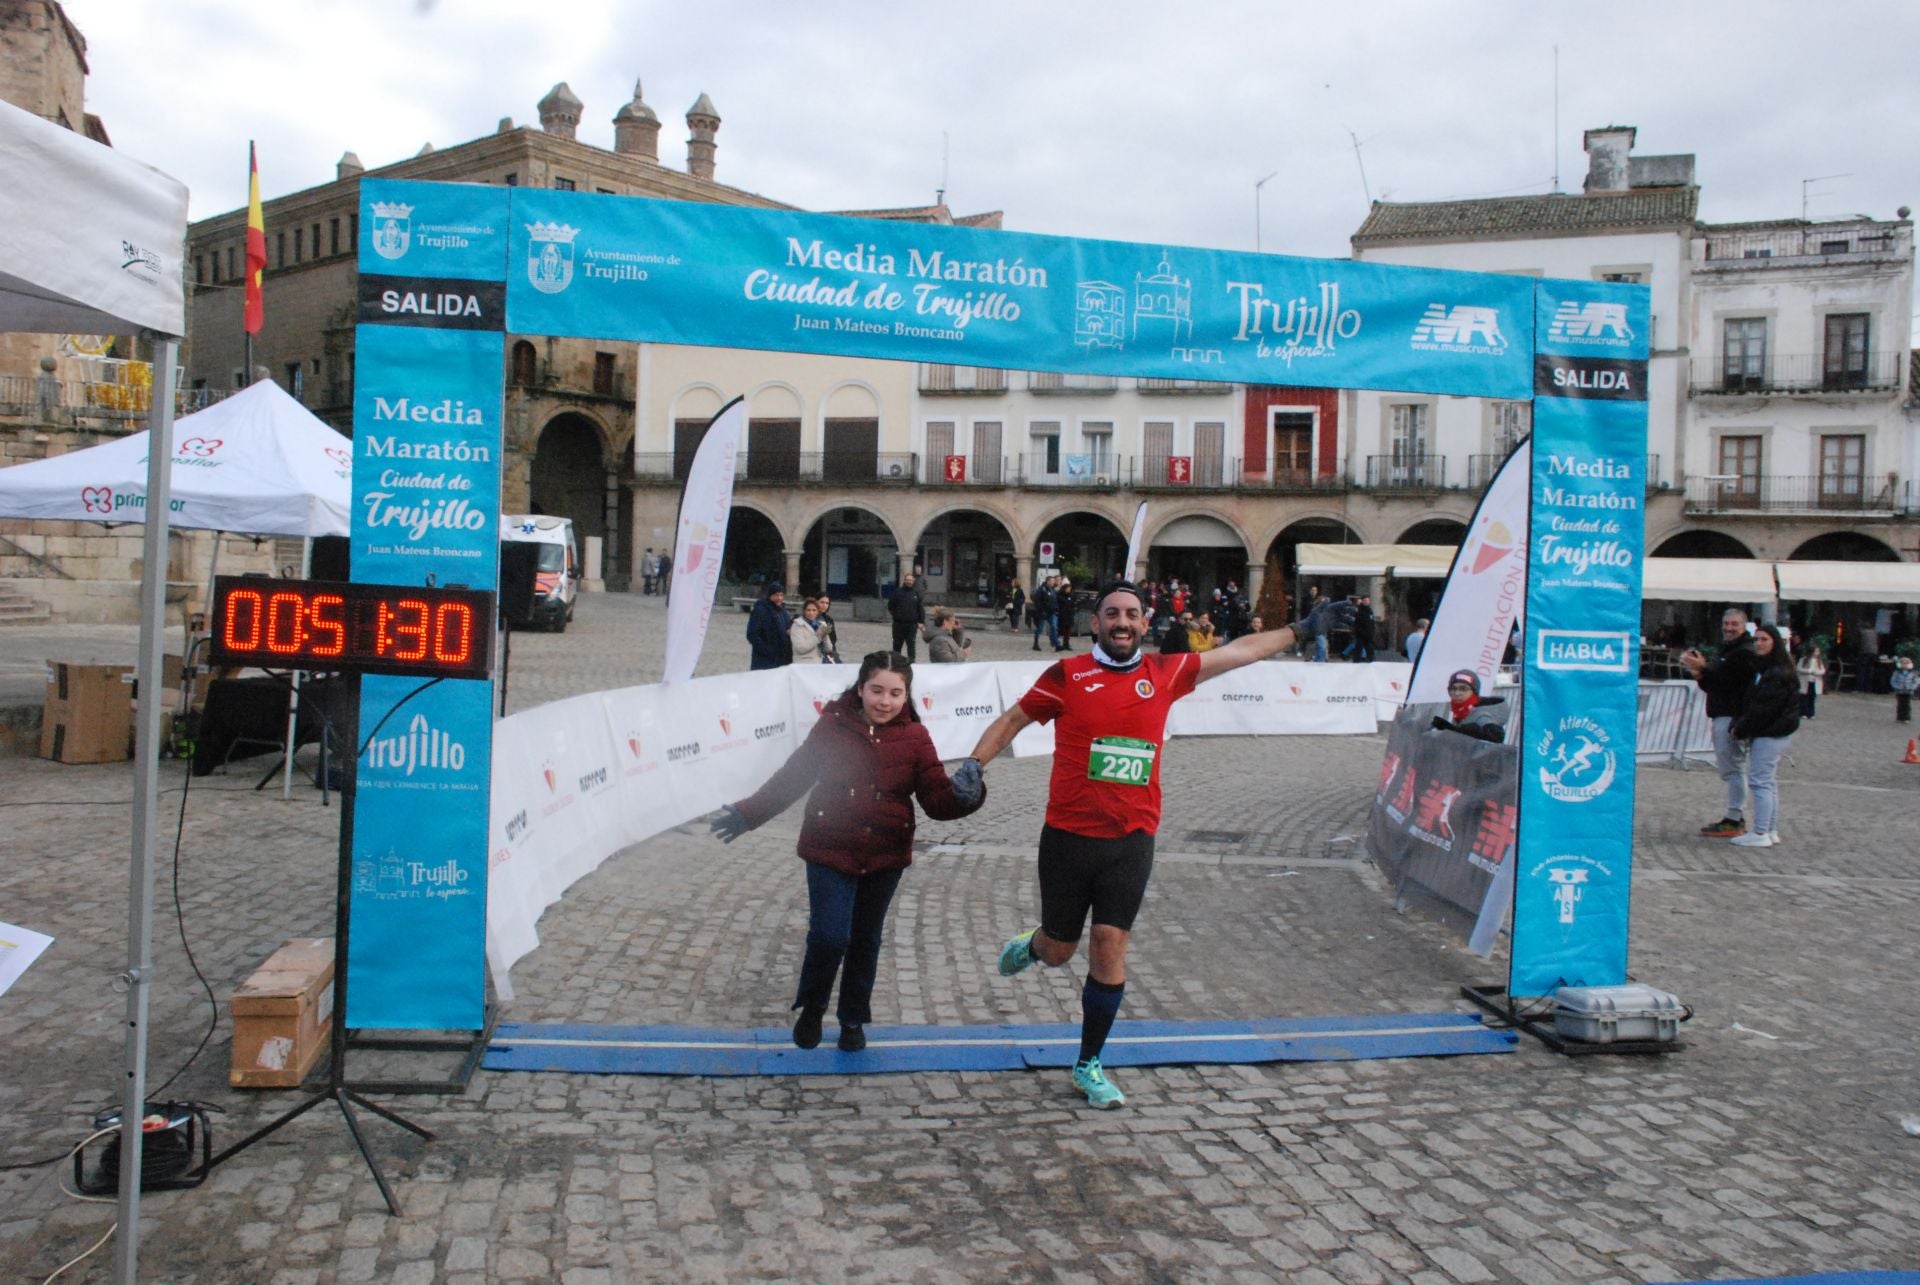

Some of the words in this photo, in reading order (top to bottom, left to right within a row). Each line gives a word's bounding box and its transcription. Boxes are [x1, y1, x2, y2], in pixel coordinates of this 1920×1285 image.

[417, 234, 469, 250] Trujillo
[418, 223, 481, 236] Ayuntamiento
[483, 226, 495, 236] de
[583, 248, 664, 265] Ayuntamiento
[666, 254, 682, 266] de
[785, 237, 896, 276] Media
[906, 248, 1048, 289] Maratón
[582, 262, 648, 284] Trujillo
[381, 290, 482, 317] SALIDA
[744, 269, 859, 308] Ciudad
[863, 282, 905, 311] de
[912, 283, 1021, 329] Trujillo
[794, 314, 830, 331] Juan
[833, 317, 890, 335] Mateos
[894, 322, 965, 341] Broncano
[1226, 281, 1361, 350] Trujillo
[1256, 337, 1272, 359] te
[1410, 342, 1505, 356] www.musicrun.es
[1547, 335, 1630, 348] www.musicrun.es
[1553, 368, 1630, 390] SALIDA
[373, 397, 484, 426] Media
[365, 435, 490, 463] Maratón
[380, 469, 444, 490] Ciudad
[447, 474, 473, 491] de
[1548, 454, 1631, 480] Media
[1542, 487, 1637, 511] Maratón
[363, 491, 486, 542] Trujillo
[1551, 514, 1600, 534] Ciudad
[1602, 518, 1621, 534] de
[368, 544, 391, 555] Juan
[394, 545, 430, 557] Mateos
[433, 546, 481, 558] Broncano
[1538, 534, 1633, 576] Trujillo
[1550, 641, 1615, 661] HABLA
[1537, 728, 1554, 757] Club
[1559, 715, 1611, 744] Atletismo
[367, 713, 465, 777] trujillo
[1101, 755, 1143, 781] 220
[1545, 781, 1598, 798] TRUJILLO
[407, 859, 468, 886] Trujillo
